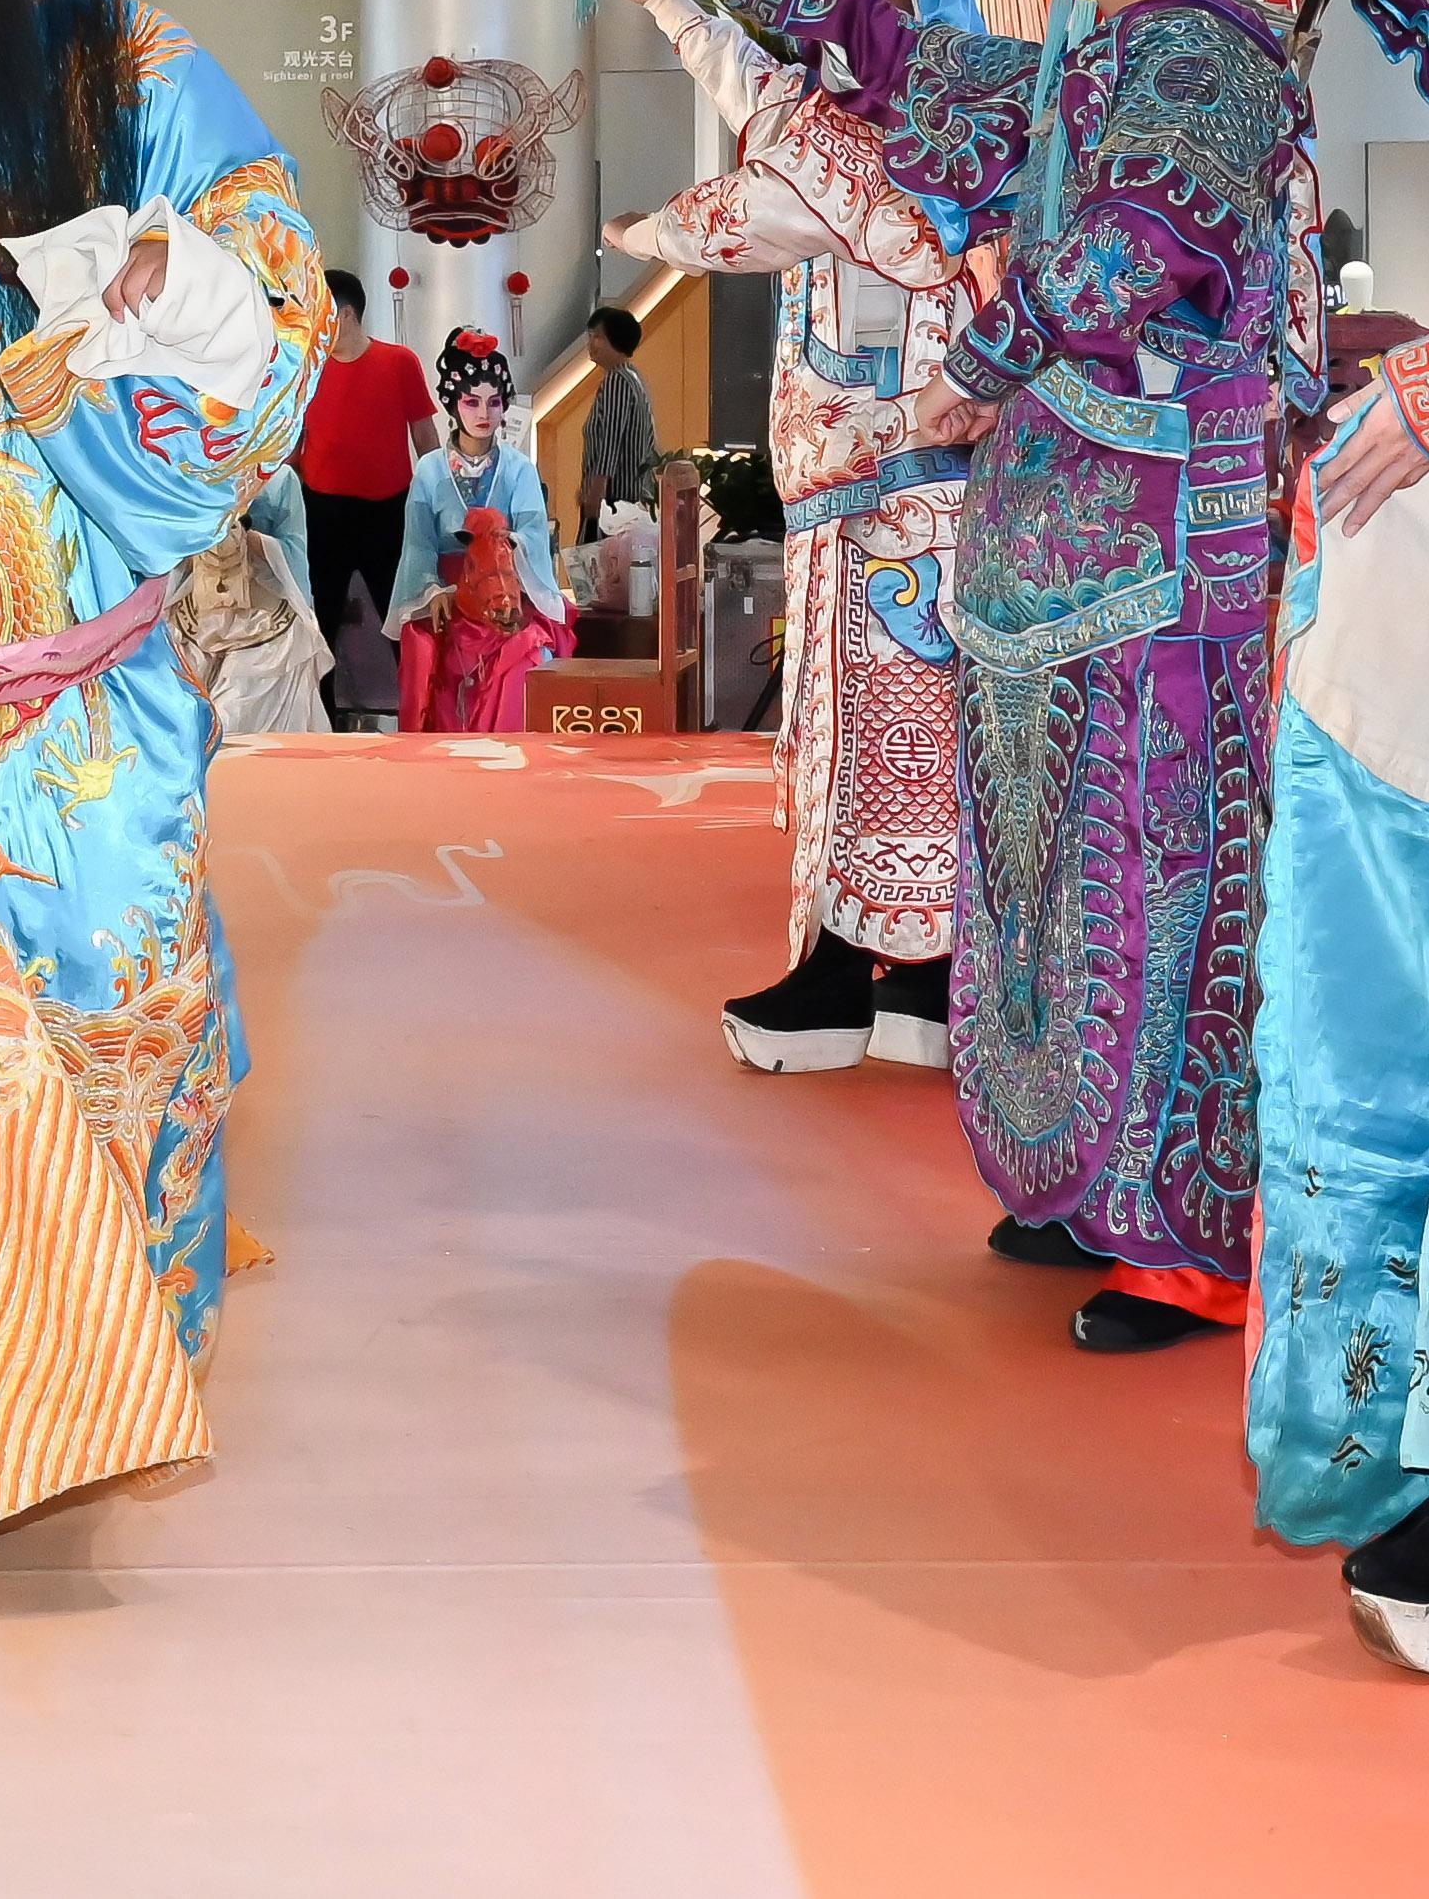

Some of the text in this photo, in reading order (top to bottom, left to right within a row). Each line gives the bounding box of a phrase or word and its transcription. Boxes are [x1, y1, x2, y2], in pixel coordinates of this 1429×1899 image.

[319, 15, 353, 44] 3F
[284, 51, 354, 68] 观光天台
[331, 71, 354, 80] roof
